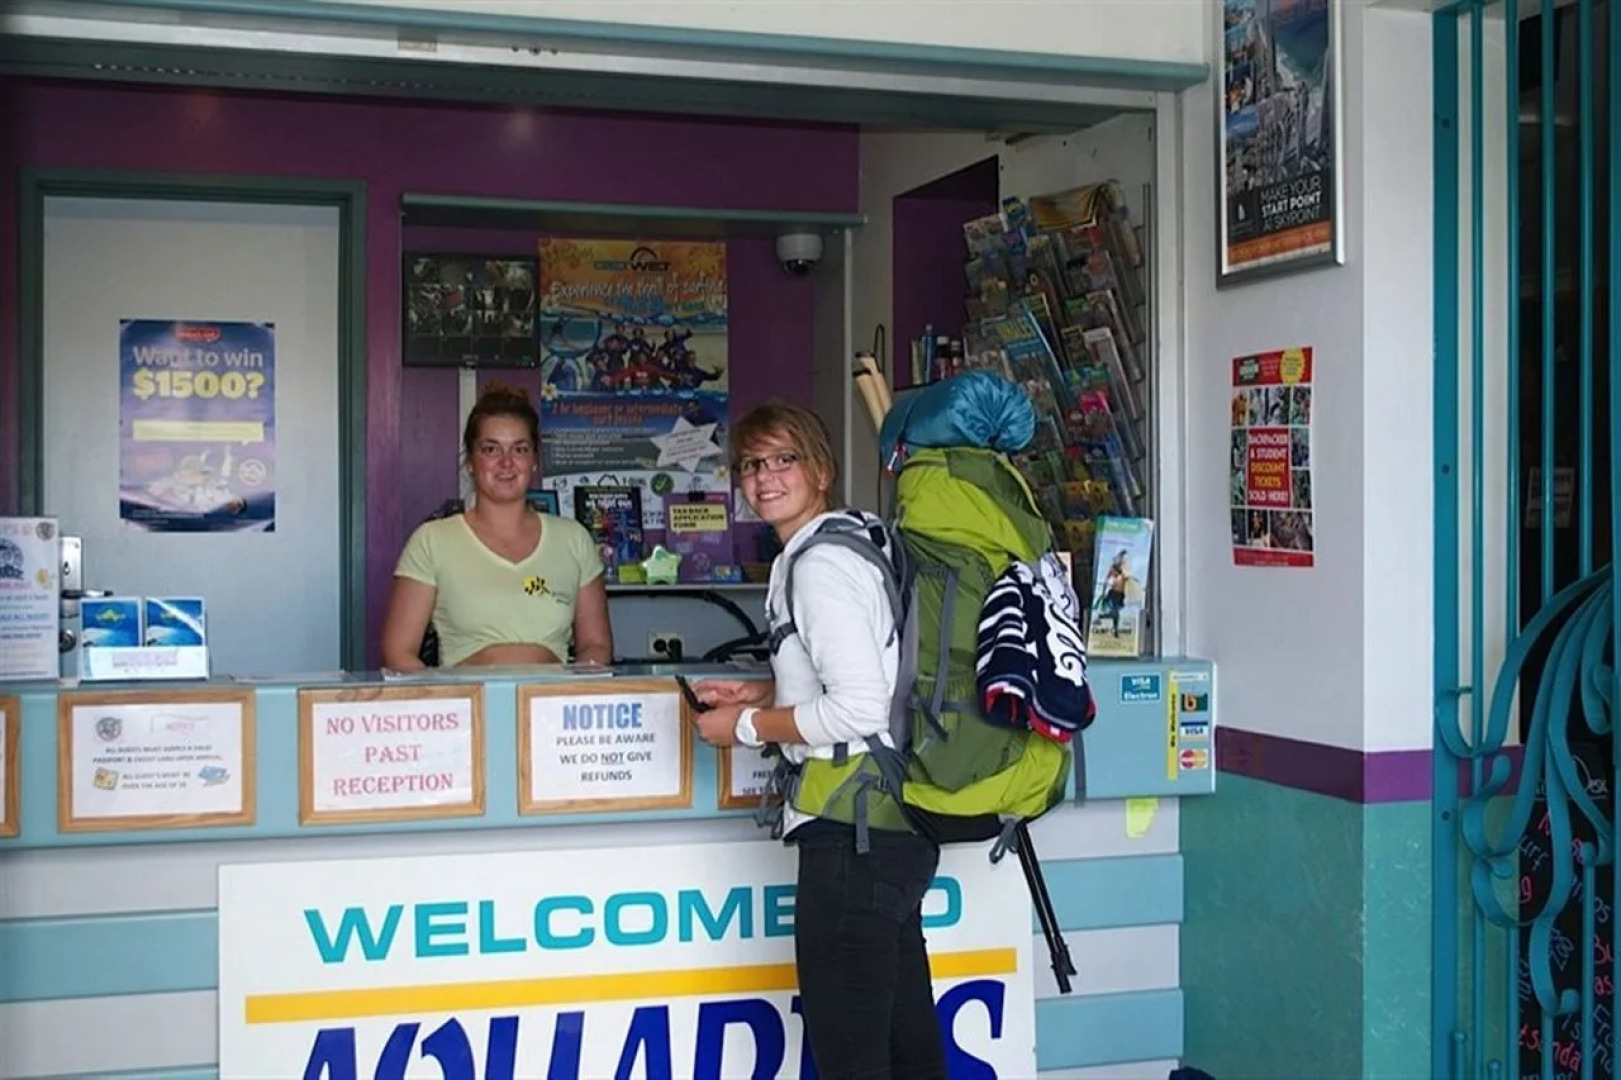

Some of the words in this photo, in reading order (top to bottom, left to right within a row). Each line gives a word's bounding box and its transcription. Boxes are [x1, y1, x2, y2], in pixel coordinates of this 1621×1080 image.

[1260, 183, 1288, 204] MAKE
[1290, 174, 1322, 195] YOUR
[1262, 198, 1289, 218] START
[1290, 190, 1322, 210] POINT
[549, 281, 613, 297] Experience
[617, 278, 634, 295] the
[133, 347, 190, 367] Want
[198, 348, 218, 367] to
[224, 348, 263, 367] win
[132, 367, 264, 400] $1500?
[1249, 433, 1288, 444] BACKPACKER
[1256, 447, 1287, 459] STUDENT
[1250, 461, 1285, 473] DISCOUNT
[1254, 475, 1281, 488] TICKETS
[1249, 490, 1266, 501] SOLD
[1131, 677, 1151, 686] VISA
[1124, 692, 1158, 700] Electron
[327, 716, 354, 735] NO
[361, 712, 459, 733] VISITORS
[563, 702, 642, 730] NOTICE
[556, 735, 595, 746] PLEASE
[598, 735, 612, 745] BE
[615, 733, 655, 744] AWARE
[365, 743, 422, 763] PAST
[559, 753, 577, 765] WE
[580, 753, 598, 764] DO
[601, 751, 624, 765] NOT
[626, 751, 652, 762] GIVE
[580, 769, 632, 782] REFUNDS
[333, 773, 454, 796] RECEPTION
[304, 885, 794, 963] WELCOME
